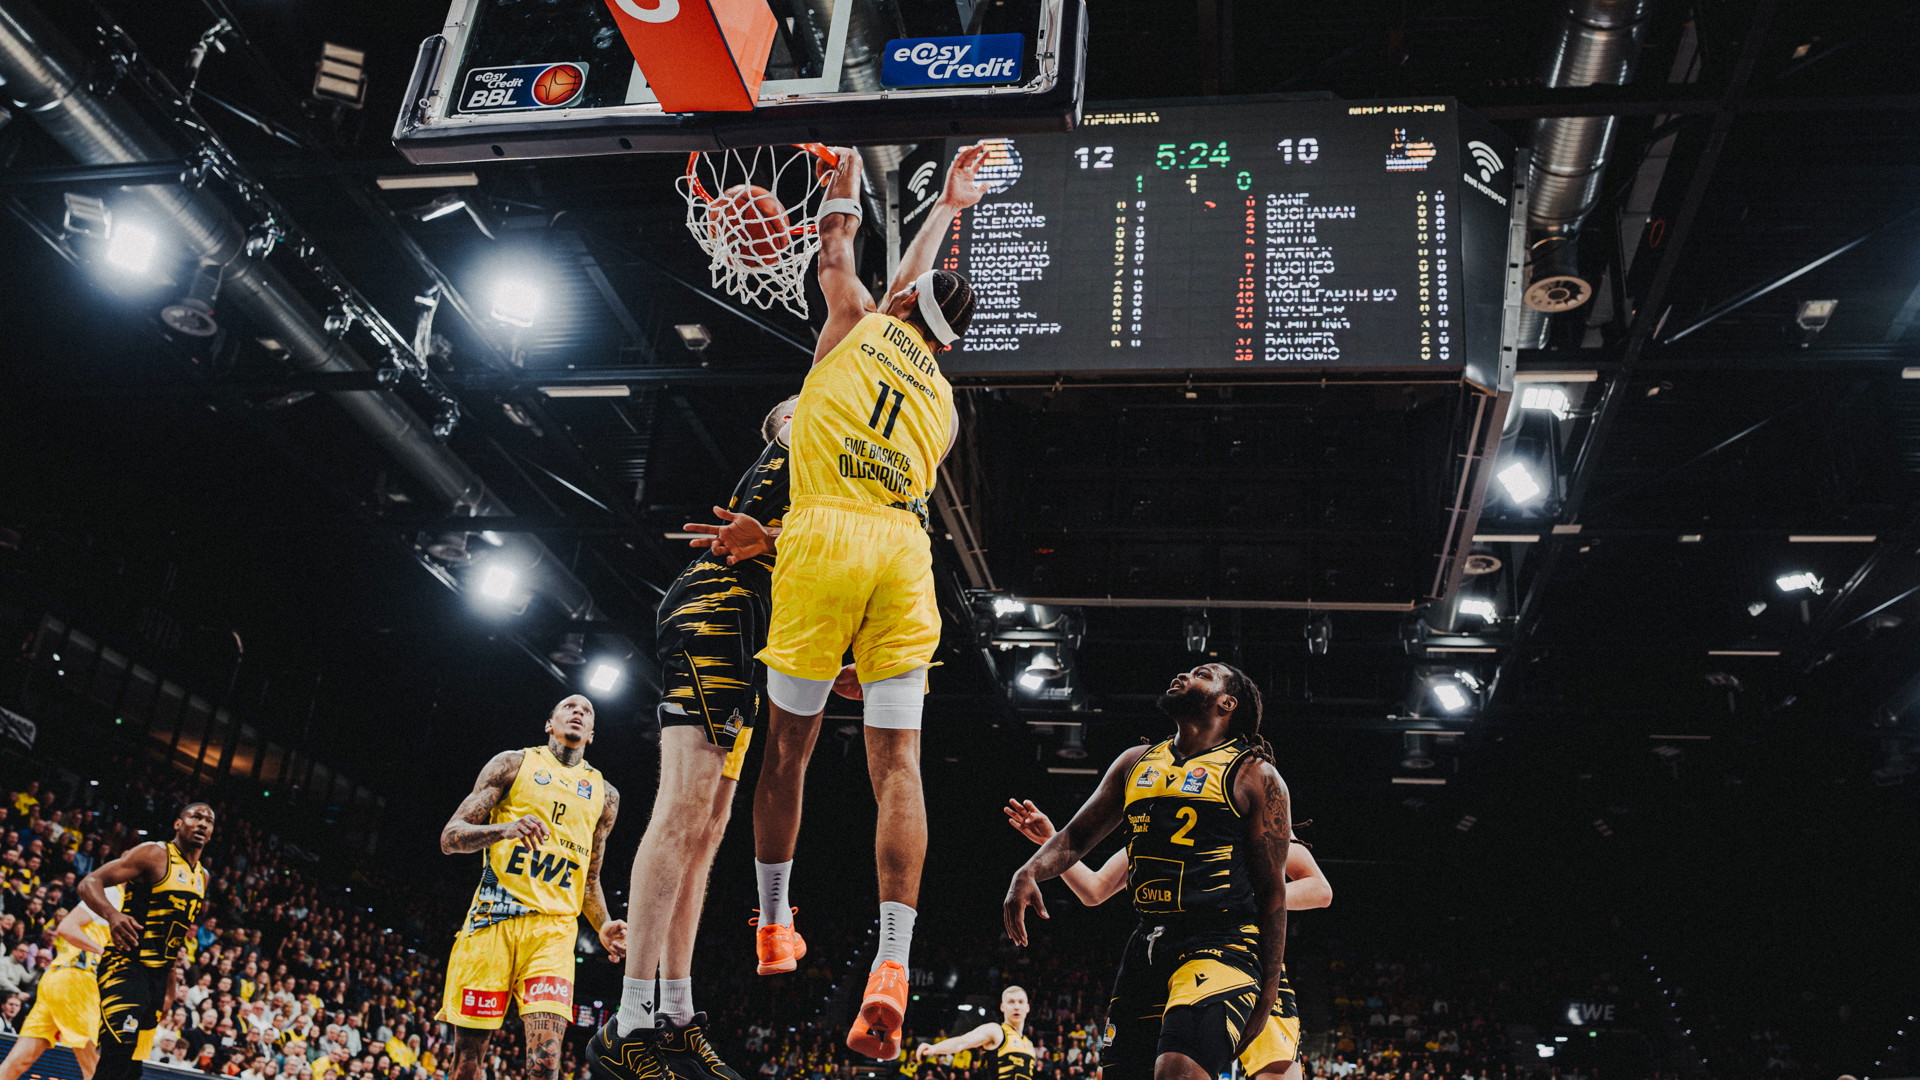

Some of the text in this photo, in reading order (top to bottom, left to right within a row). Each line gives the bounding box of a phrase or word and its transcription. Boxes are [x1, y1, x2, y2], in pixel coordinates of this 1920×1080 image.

[927, 57, 1015, 80] Credit
[487, 78, 523, 89] Credit
[467, 88, 517, 108] BBL
[1075, 146, 1114, 169] 12
[1156, 141, 1231, 170] 5:24
[1277, 138, 1319, 164] 10
[1236, 171, 1252, 191] 0
[1477, 182, 1507, 206] HOTSPOT
[973, 202, 1033, 217] LOFTON
[972, 215, 1046, 230] CLEMONS
[969, 254, 1051, 269] WOODARD
[968, 268, 1043, 282] TISCHLER
[882, 321, 937, 378] TISCHLER
[1264, 347, 1340, 361] DONGMO
[876, 352, 936, 400] CleverReach
[868, 380, 906, 440] 11
[868, 443, 912, 473] BASKETS
[551, 801, 567, 826] 12
[1170, 806, 1198, 847] 2
[505, 845, 580, 889] EWE
[1142, 887, 1172, 902] SWLB
[529, 982, 569, 997] cewe
